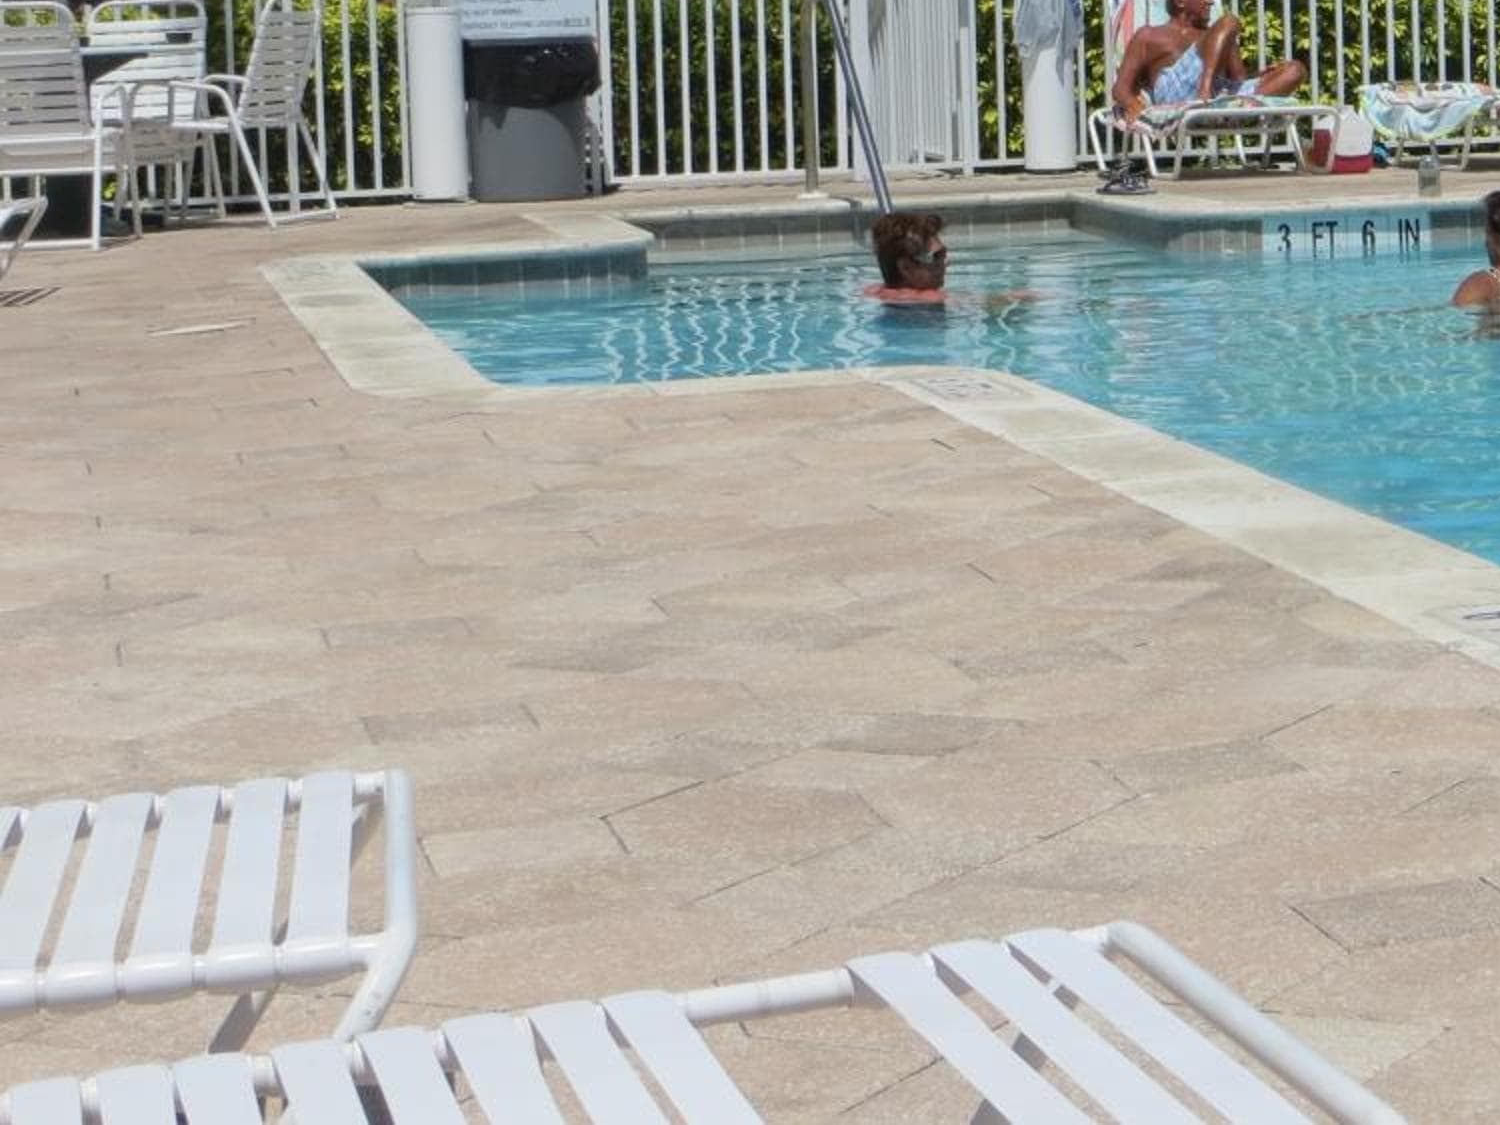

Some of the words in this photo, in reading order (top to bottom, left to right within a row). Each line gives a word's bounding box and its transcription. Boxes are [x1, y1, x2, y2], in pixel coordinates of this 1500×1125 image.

[1277, 222, 1292, 254] 3
[1311, 220, 1339, 259] FT
[1361, 220, 1376, 259] 6
[1397, 218, 1420, 255] IN
